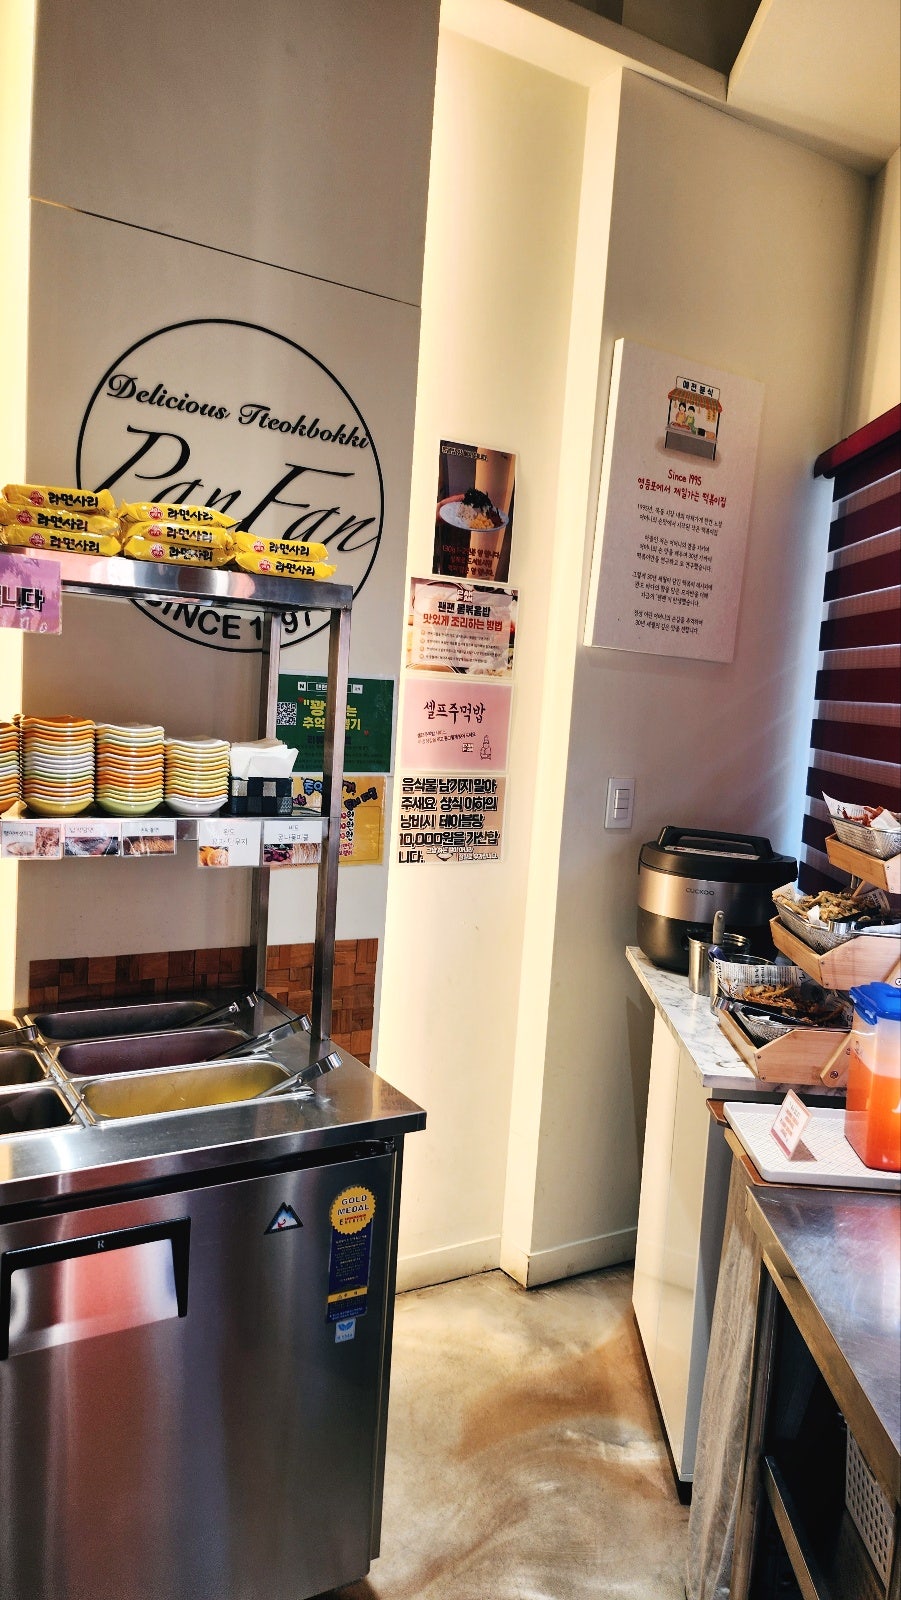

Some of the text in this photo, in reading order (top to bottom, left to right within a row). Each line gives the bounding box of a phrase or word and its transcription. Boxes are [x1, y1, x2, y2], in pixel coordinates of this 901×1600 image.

[106, 374, 230, 419] Delicious
[668, 469, 702, 486] Since 1995
[48, 492, 98, 507] 라면사리
[637, 477, 727, 508] 영등포에서 제일가는 떡볶이집
[37, 513, 88, 532] 라면사리
[167, 507, 214, 522] 라면사리
[166, 526, 213, 543] 라면사리
[50, 536, 99, 553] 라면사리
[269, 542, 310, 556] 라면사리
[169, 546, 213, 562] 라면사리
[275, 561, 315, 576] 라면사리
[0, 586, 45, 612] 니다
[423, 613, 503, 632] 맛있게 조리하는 방법
[424, 700, 486, 724] 셀프주먹밥
[402, 777, 498, 794] 음식물 남기지 말아
[440, 796, 464, 812] 상식
[464, 796, 498, 811] 이하의
[400, 813, 485, 829] 낭비시 테이블당
[466, 831, 500, 846] 가산합
[686, 887, 715, 896] CUCKOO
[341, 1194, 367, 1205] GOLD
[337, 1204, 369, 1215] MEDAL
